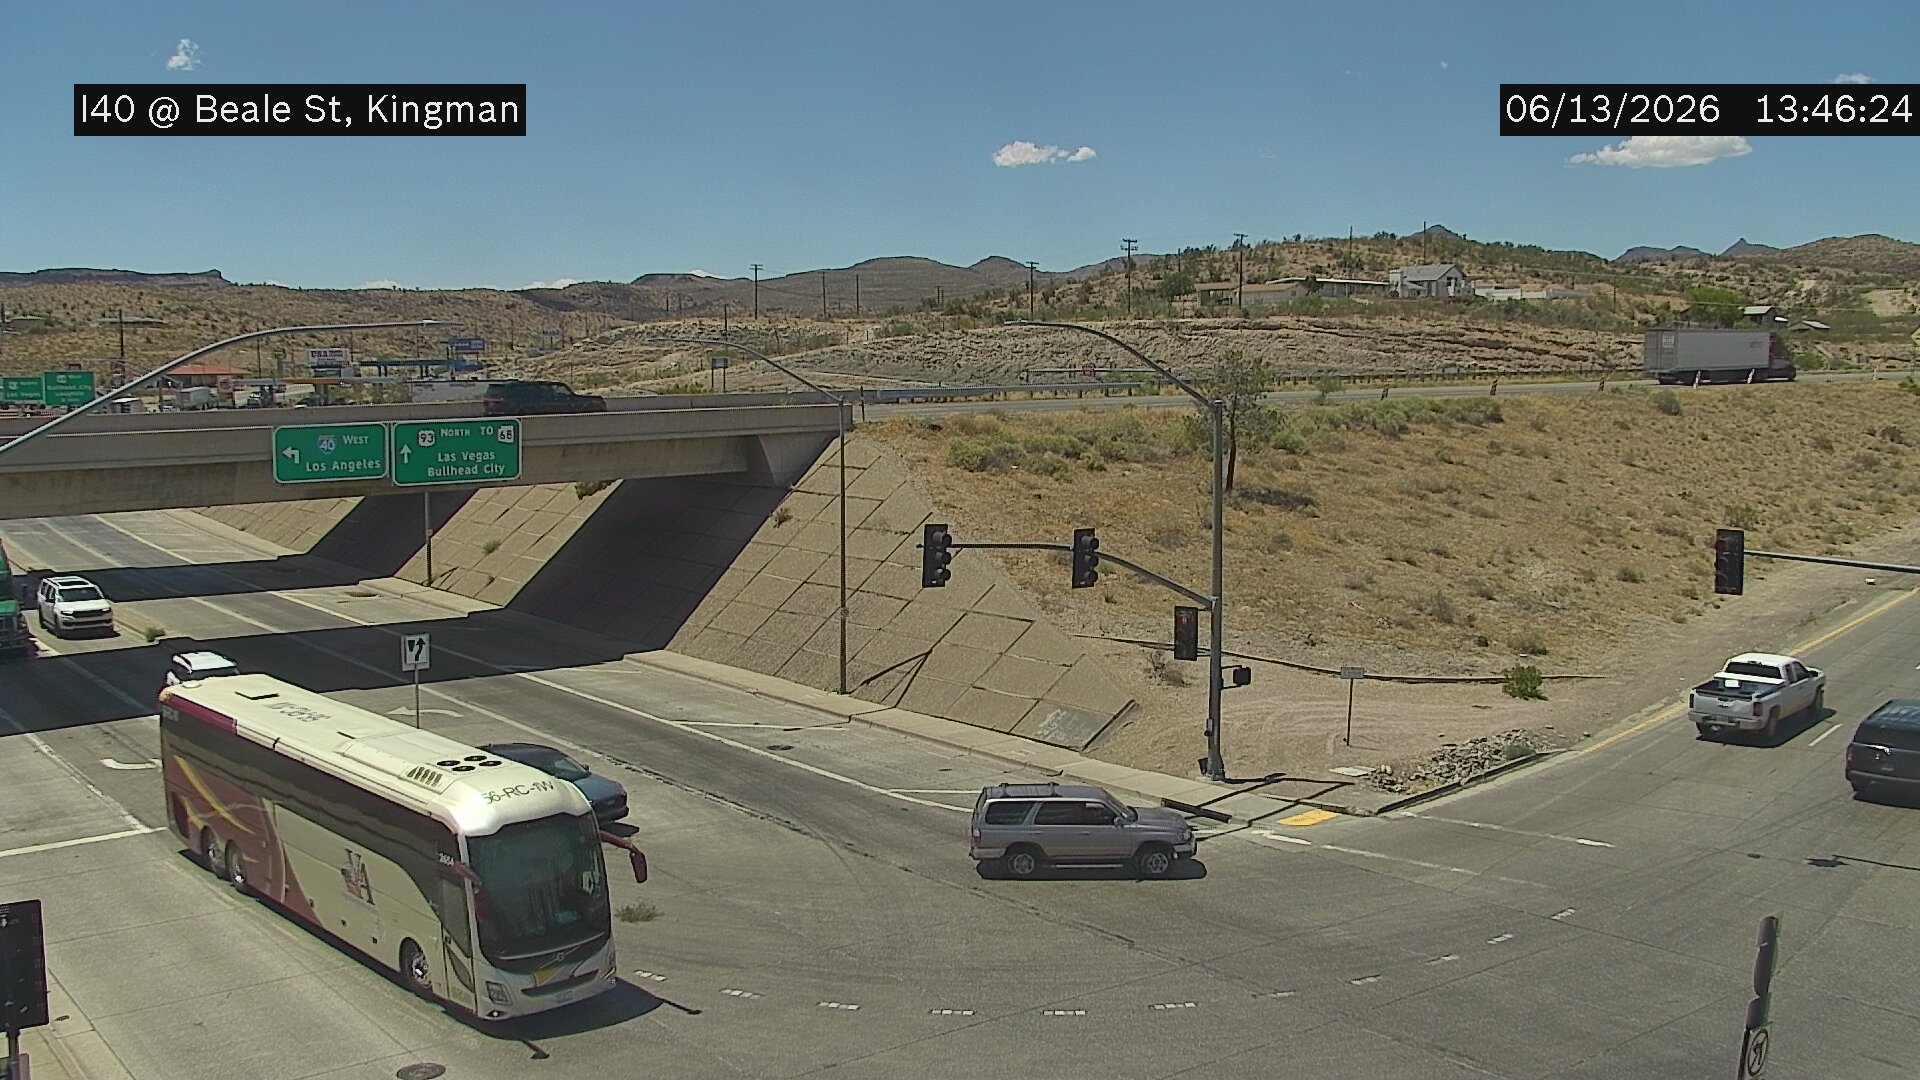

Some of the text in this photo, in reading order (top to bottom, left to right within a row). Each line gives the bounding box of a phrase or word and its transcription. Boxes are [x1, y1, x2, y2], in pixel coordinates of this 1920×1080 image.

[420, 425, 513, 443] 93 NORTH TO 68
[319, 434, 369, 452] 40 WEST
[437, 450, 496, 463] Las Vegas
[305, 458, 382, 473] Los Angeles
[427, 463, 506, 477] Bullhead City
